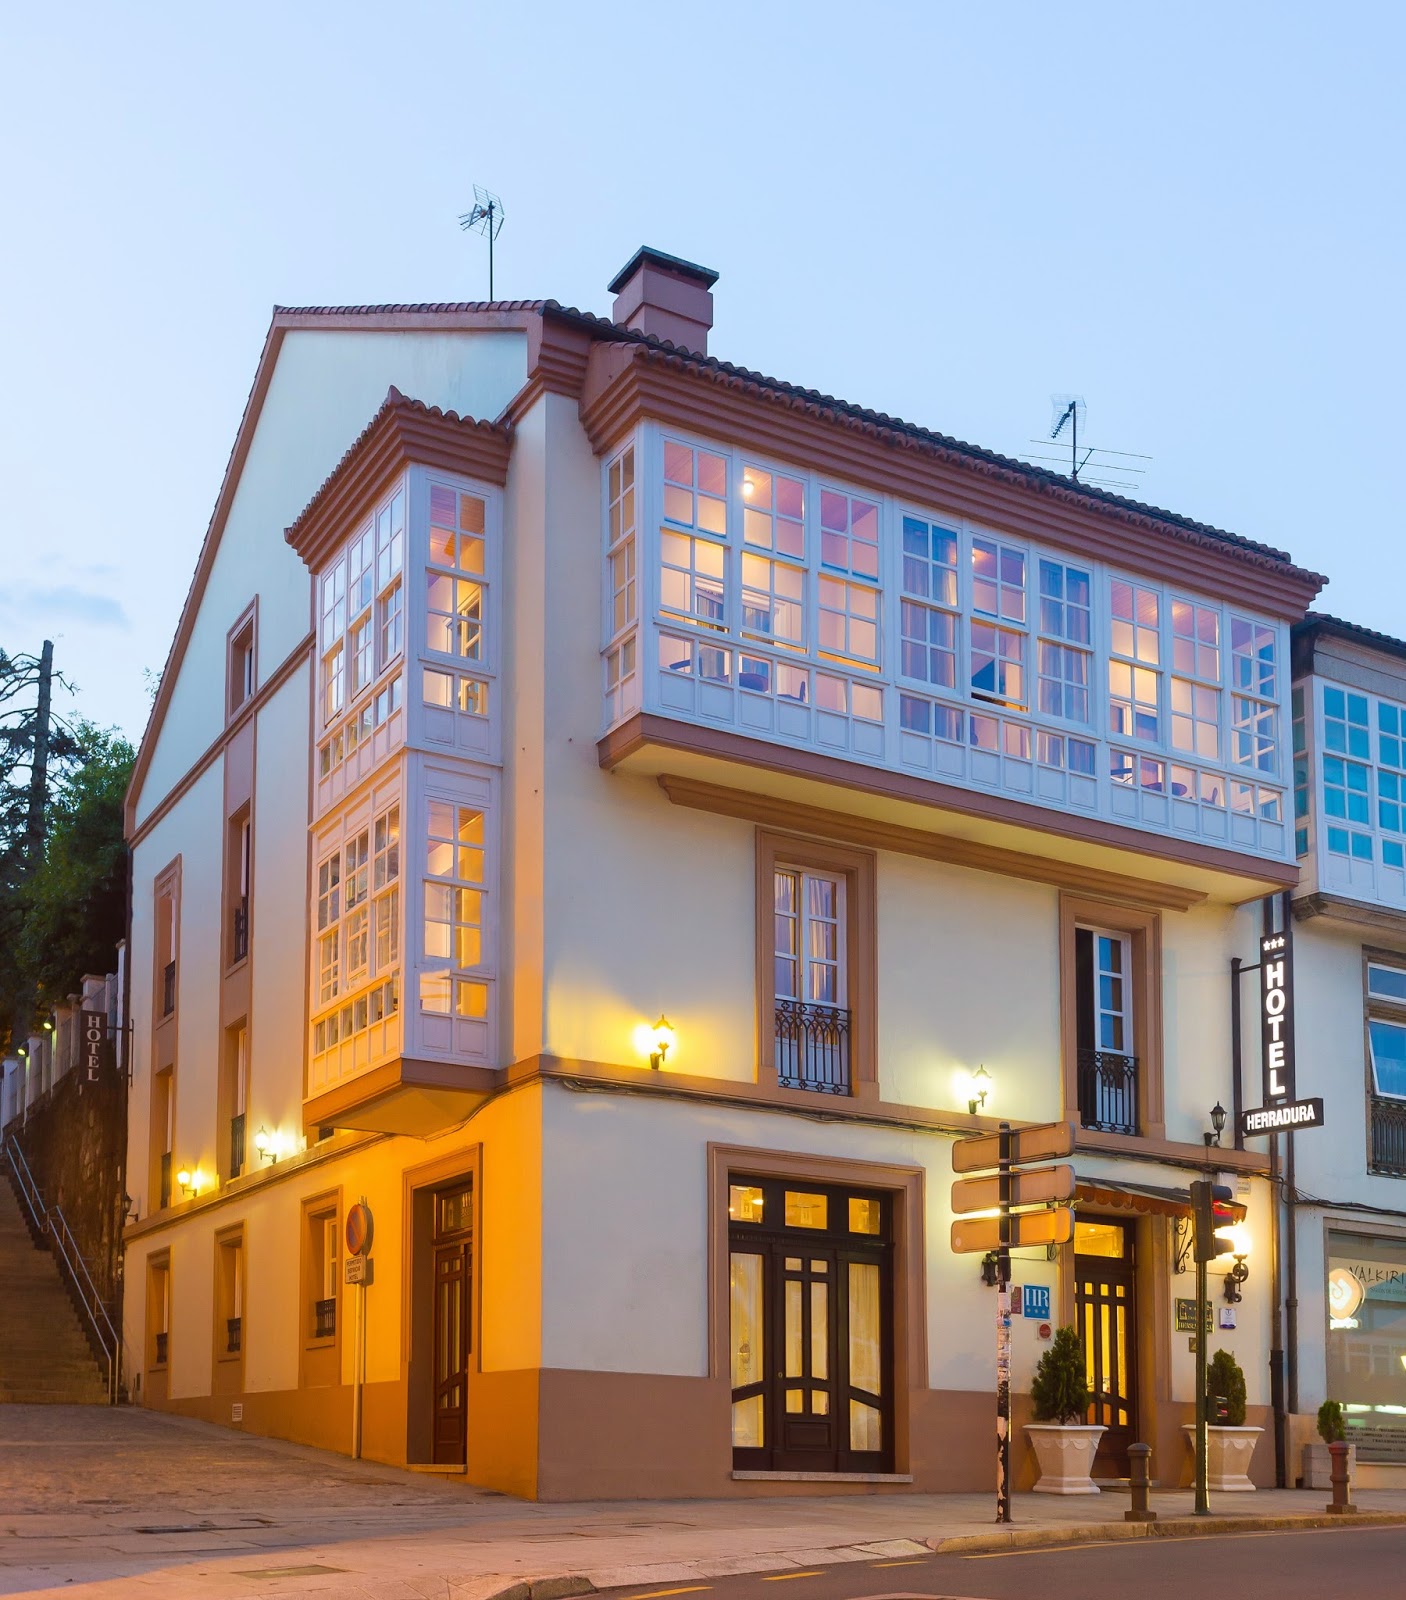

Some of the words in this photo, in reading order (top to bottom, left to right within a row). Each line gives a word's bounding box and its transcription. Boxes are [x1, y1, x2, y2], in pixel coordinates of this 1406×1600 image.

[86, 1015, 101, 1081] HOTEL
[1266, 961, 1286, 1096] HOTEL
[1246, 1104, 1316, 1131] HERRADURA
